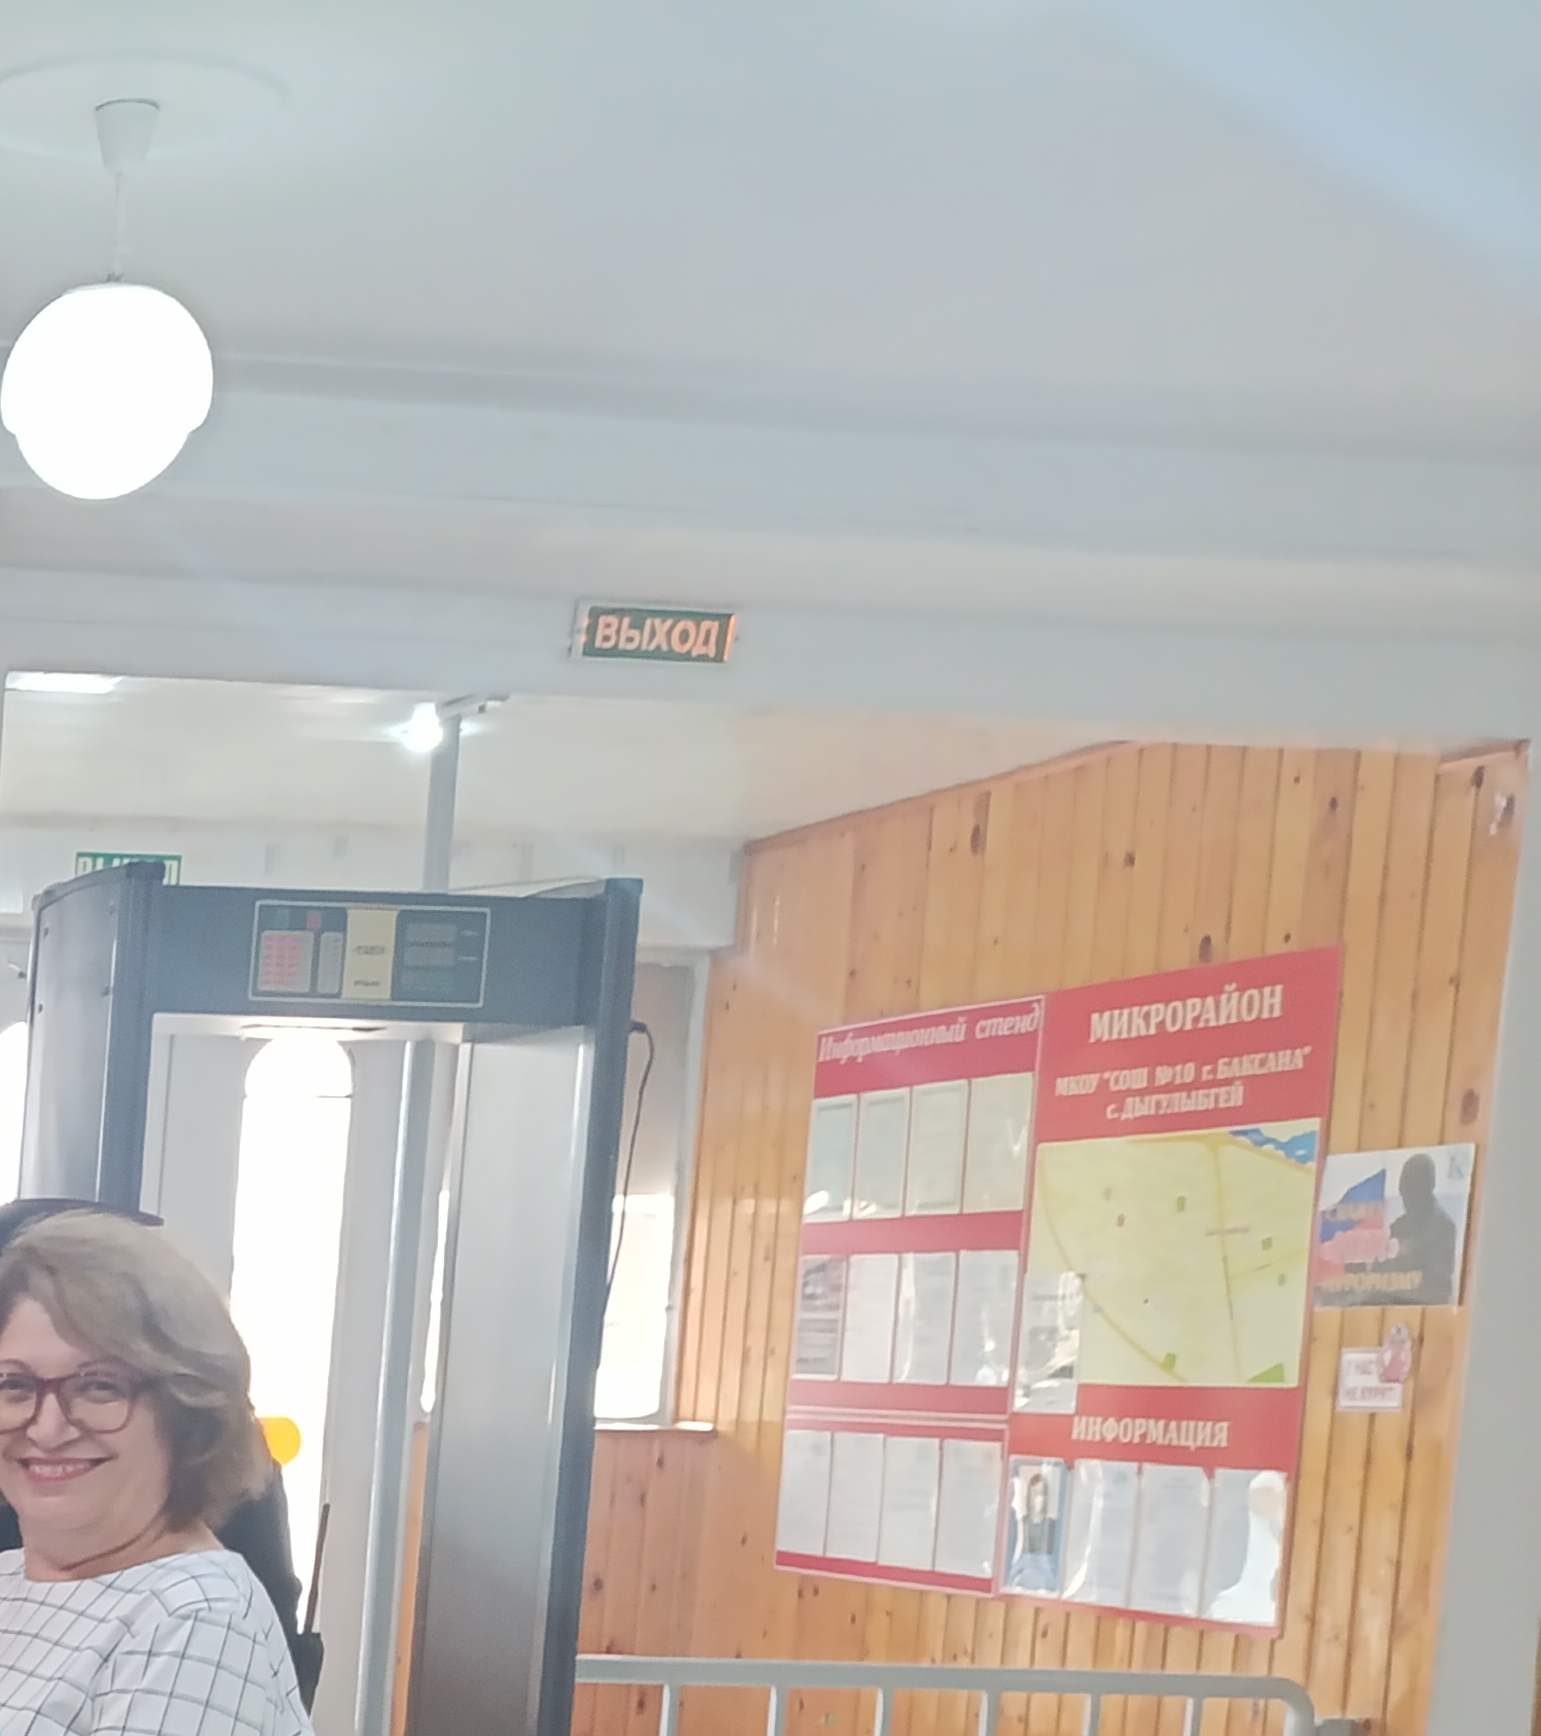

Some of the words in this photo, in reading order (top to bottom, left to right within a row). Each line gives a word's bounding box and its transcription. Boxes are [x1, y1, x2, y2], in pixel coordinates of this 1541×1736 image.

[594, 614, 720, 659] ВЫХОД
[818, 1016, 967, 1065] Информационный
[974, 1002, 1041, 1040] стенд
[1089, 984, 1284, 1043] МИКРОРАЙОН
[1071, 1415, 1230, 1452] ИНФОРМАЦИЯ
